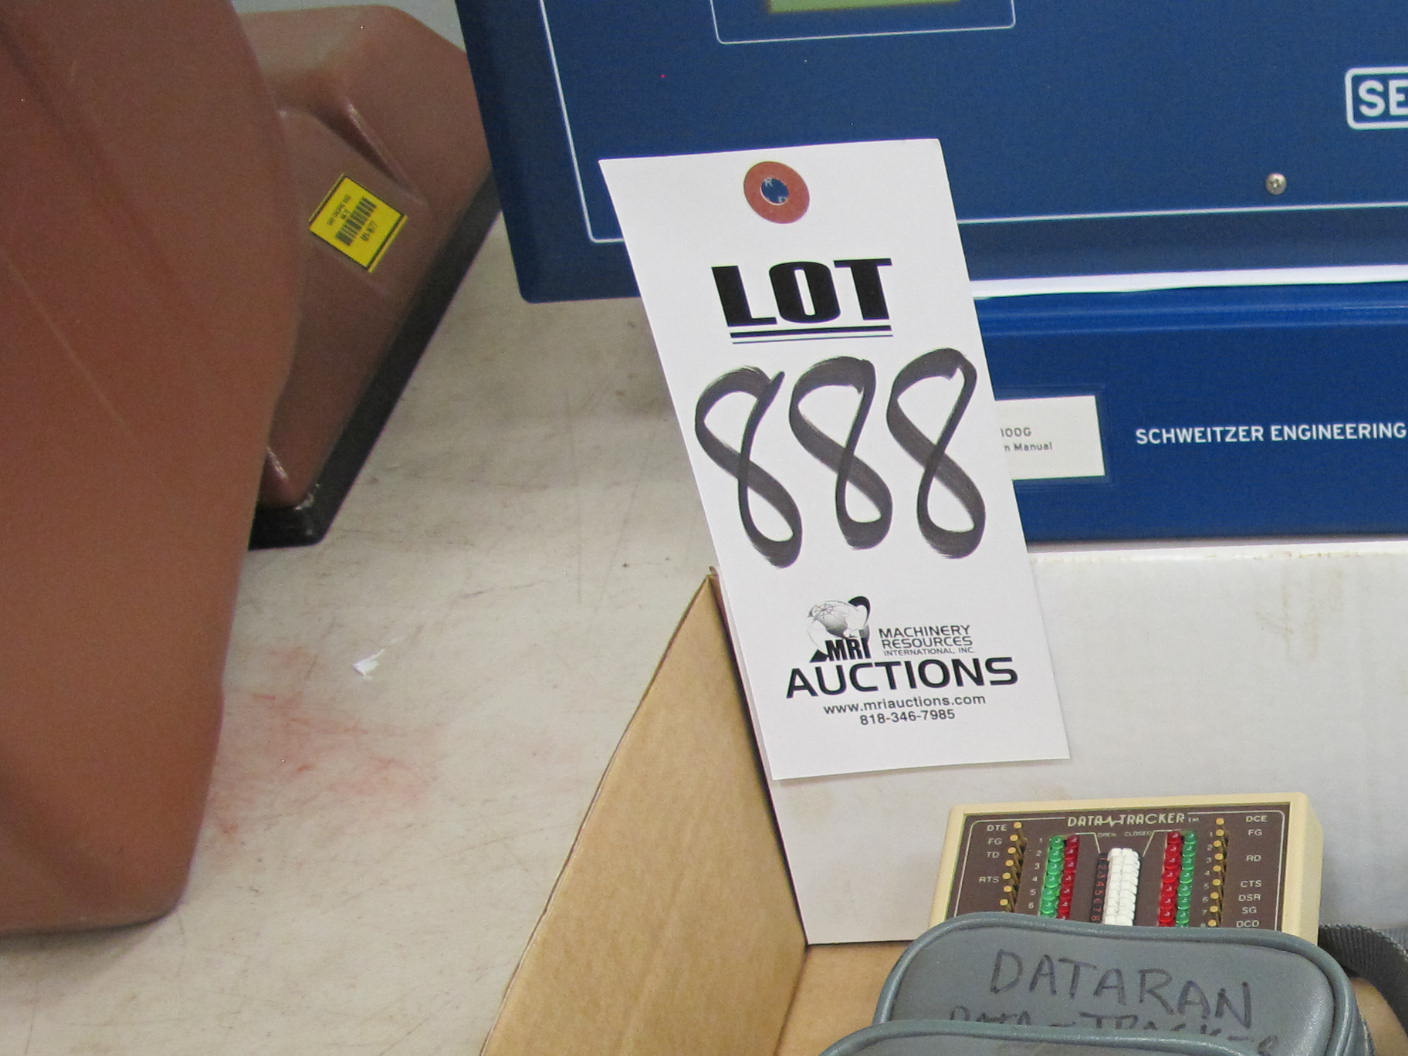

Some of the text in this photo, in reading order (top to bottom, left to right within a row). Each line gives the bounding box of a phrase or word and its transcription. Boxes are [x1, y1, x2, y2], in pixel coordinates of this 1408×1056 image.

[711, 257, 893, 327] LOT
[1135, 424, 1265, 446] SCHWEITZER
[1270, 421, 1407, 442] ENGINEERING
[1013, 442, 1053, 451] Manual
[695, 347, 986, 568] 888
[879, 625, 970, 638] MACHINERY
[825, 636, 871, 661] MRI
[882, 636, 973, 649] RESOURCES
[786, 656, 1019, 699] AUCTIONS
[824, 694, 986, 715] www.mriauctions.com
[860, 709, 955, 725] 818-346-7985
[1067, 814, 1103, 827] DATA
[1119, 813, 1185, 825] TRACKER
[1246, 815, 1268, 823] DCE
[987, 824, 1008, 832] DTE
[1248, 829, 1263, 837] FG
[988, 838, 1002, 846] FG
[986, 851, 1000, 859] TD
[1240, 880, 1262, 888] CTS
[1241, 906, 1257, 914] SG
[990, 949, 1251, 1029] DATARAN
